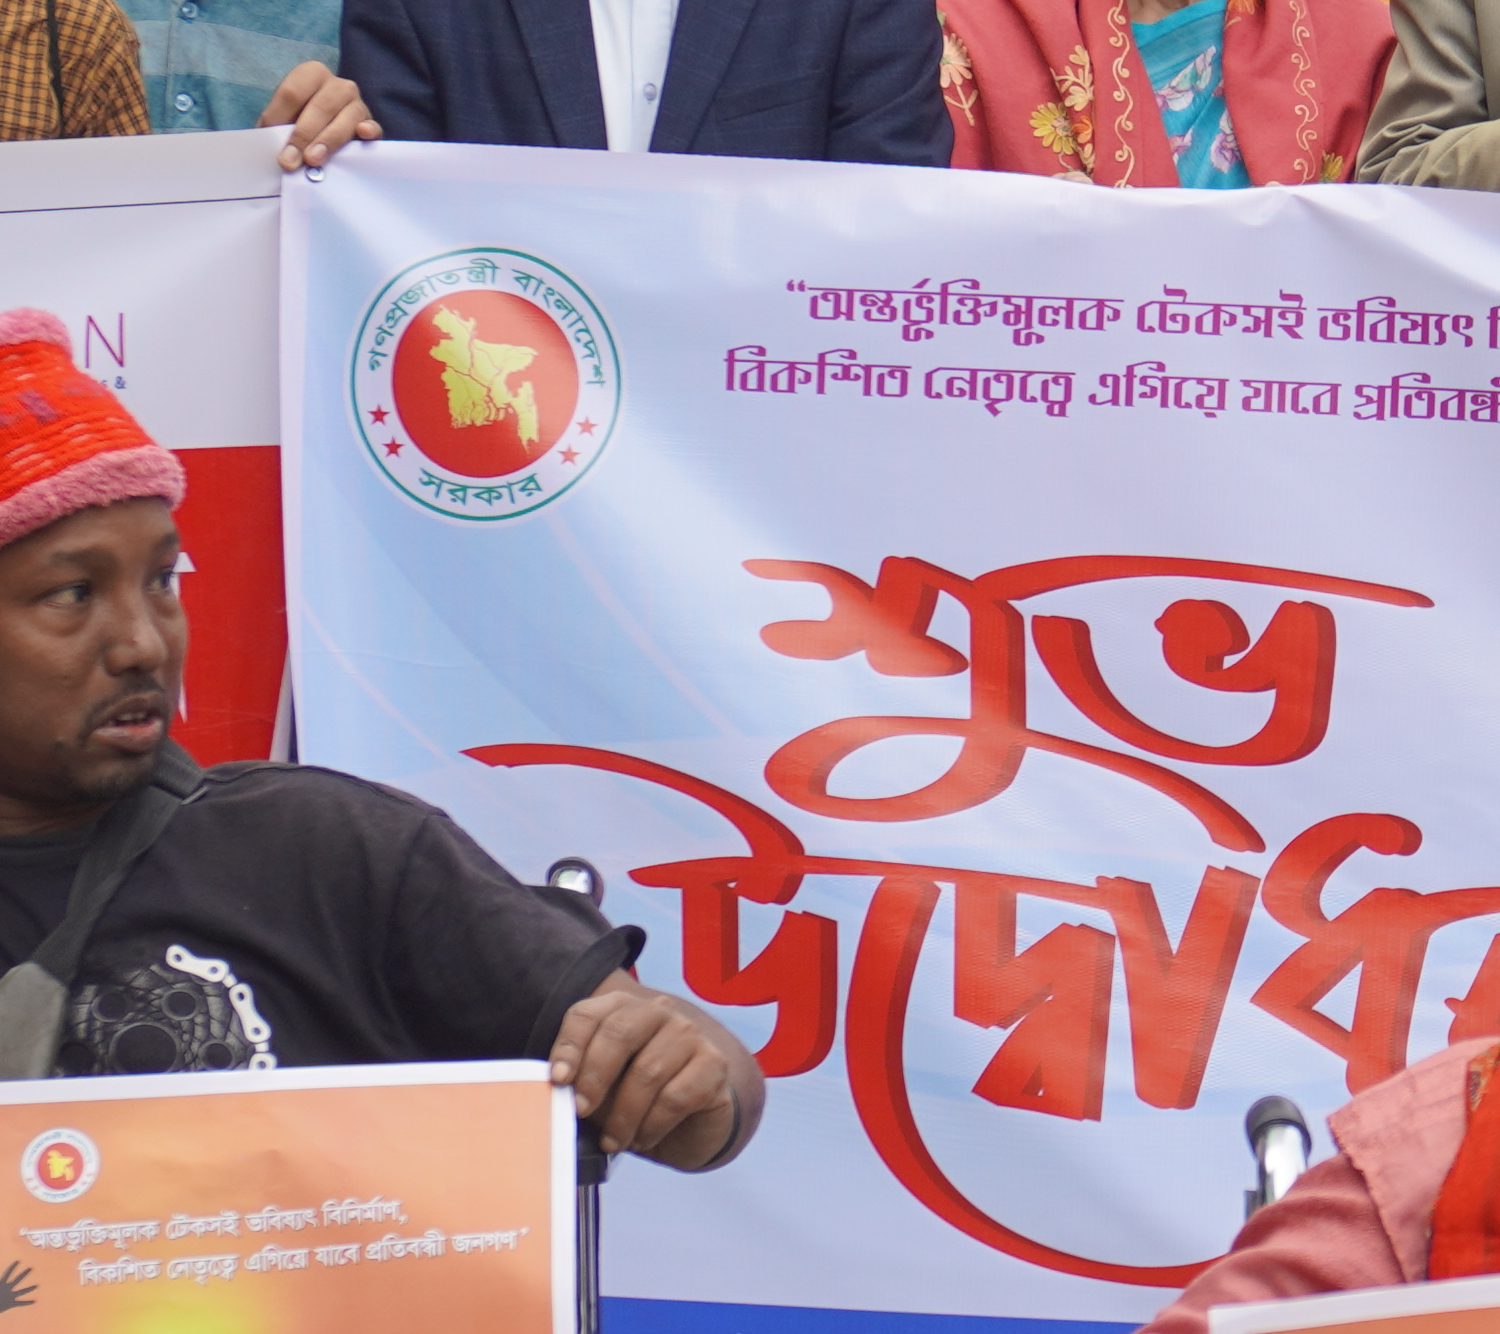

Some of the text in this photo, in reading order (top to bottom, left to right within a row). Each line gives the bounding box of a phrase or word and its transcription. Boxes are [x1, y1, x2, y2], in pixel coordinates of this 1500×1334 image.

[511, 269, 606, 386] বাংলাদেশ
[1135, 285, 1307, 339] টেকসই
[1317, 296, 1474, 347] ভবিষ্যৎ
[722, 345, 911, 398] বিকশিত
[922, 366, 1077, 417] নেতৃত্বে
[1087, 360, 1230, 419] এগিয়ে
[1240, 378, 1342, 418] যাবে
[419, 468, 542, 506] সরকার
[741, 554, 1434, 853] শুভ
[165, 1209, 241, 1240] টেকসই
[244, 1205, 319, 1232] ভবিষ্যৎ
[77, 1255, 162, 1286] বিকশিত
[167, 1255, 240, 1286] নেতৃত্বে
[244, 1243, 310, 1273] এগিয়ে
[315, 1242, 361, 1268] যাবে
[365, 1228, 447, 1262] প্রতিবন্ধী
